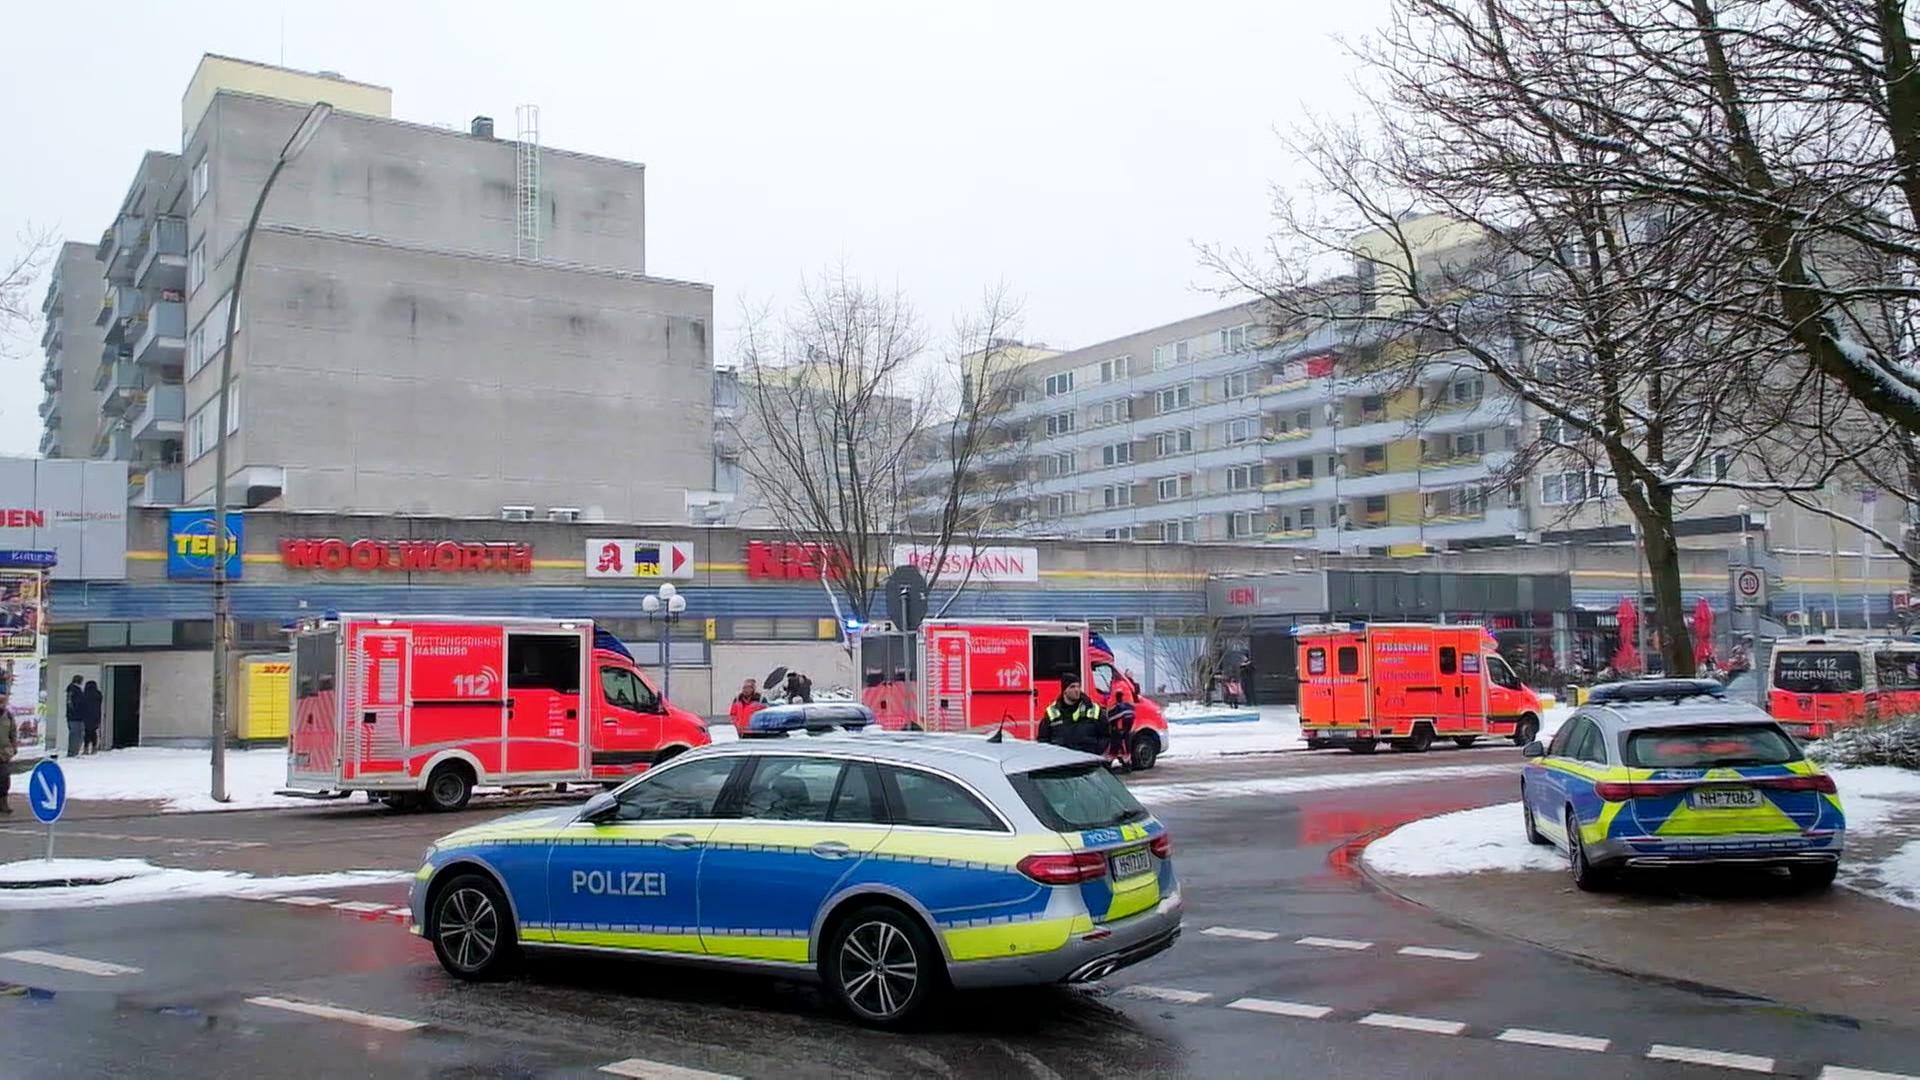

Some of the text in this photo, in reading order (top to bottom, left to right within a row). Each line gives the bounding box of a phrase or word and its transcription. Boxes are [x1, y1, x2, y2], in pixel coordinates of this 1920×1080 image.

[281, 539, 534, 573] WOOLWORTH
[1816, 657, 1837, 669] 112
[996, 668, 1022, 688] 112
[1781, 669, 1853, 680] FEUERWEHR
[453, 674, 491, 697] 112
[572, 870, 667, 896] POLIZEI
